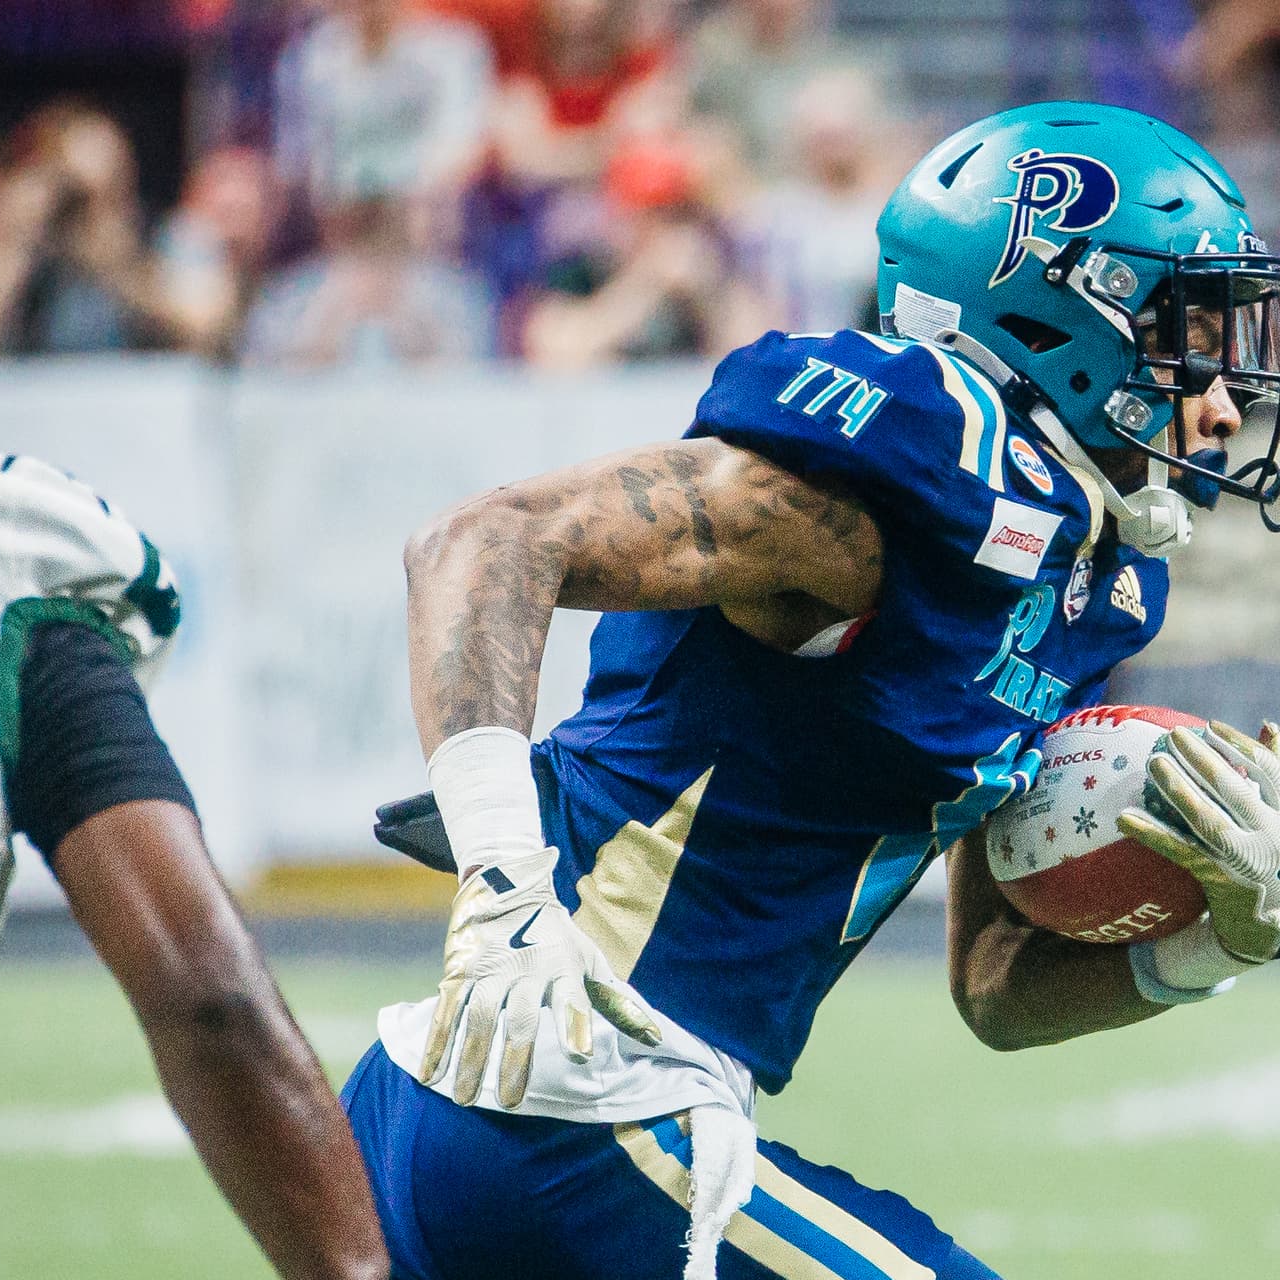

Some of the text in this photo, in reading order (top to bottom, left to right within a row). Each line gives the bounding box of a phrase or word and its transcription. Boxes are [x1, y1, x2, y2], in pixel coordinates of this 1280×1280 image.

[776, 356, 888, 439] 774
[1014, 451, 1048, 479] Gulf
[1111, 590, 1147, 625] adidas
